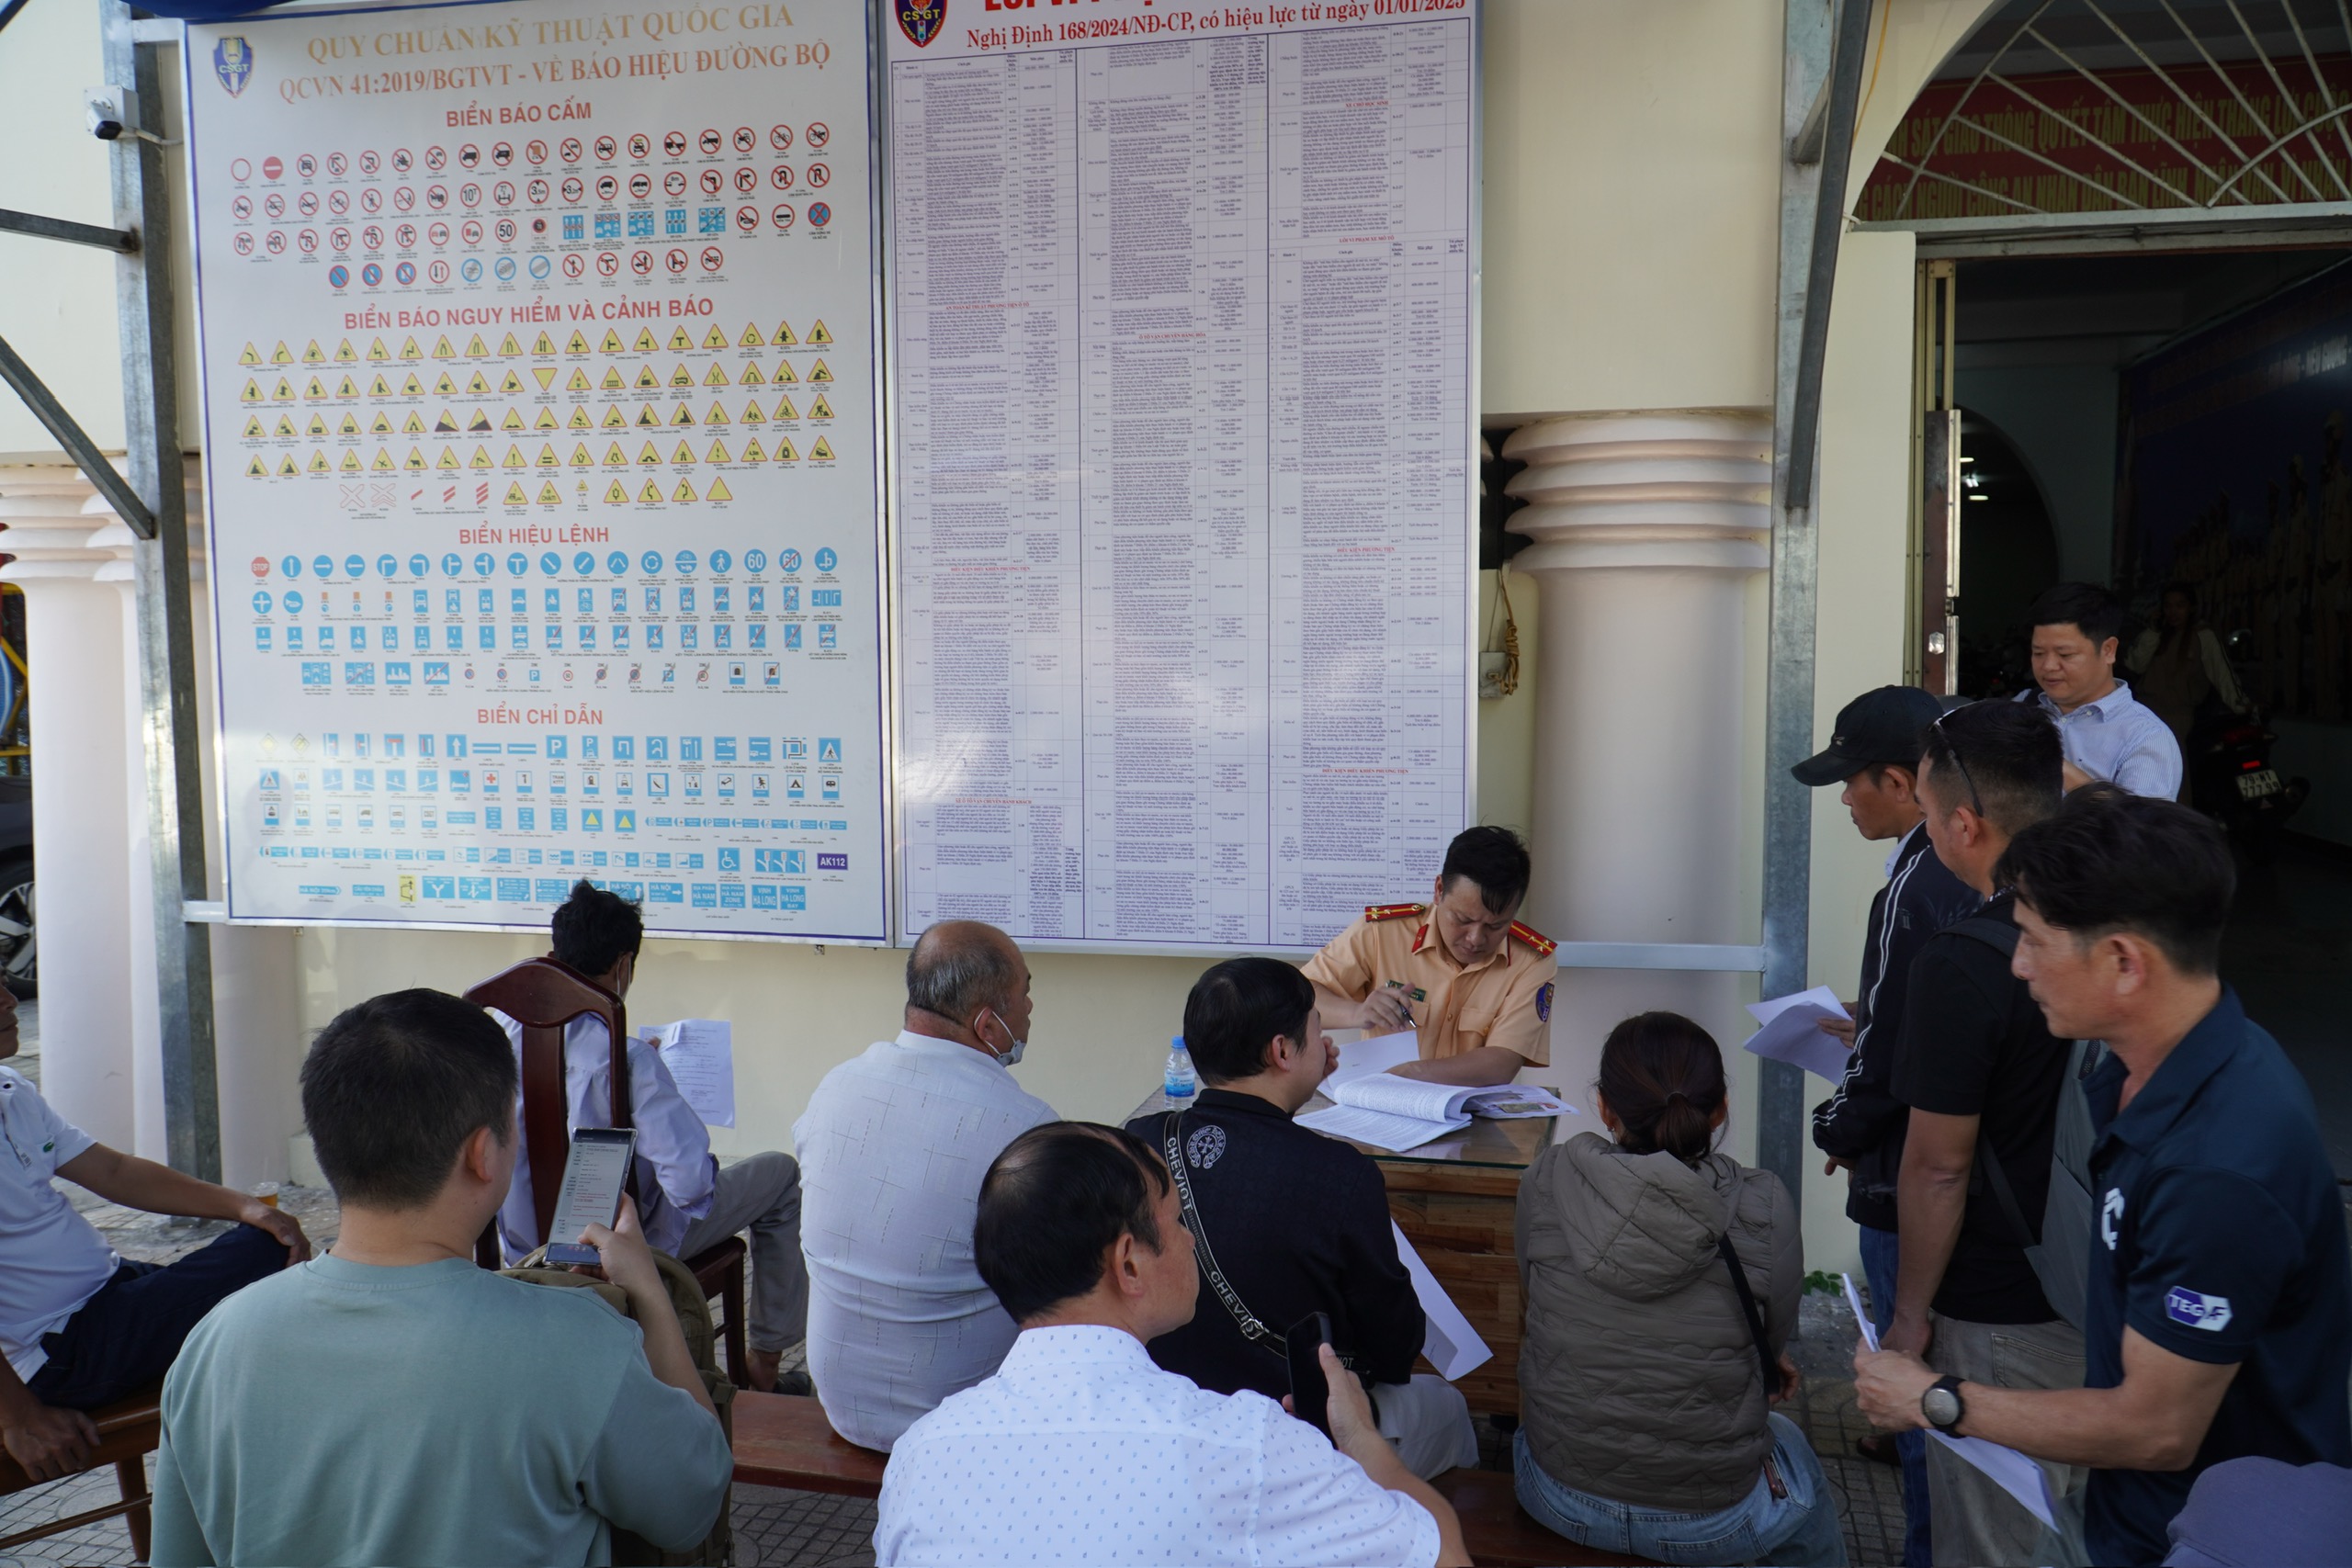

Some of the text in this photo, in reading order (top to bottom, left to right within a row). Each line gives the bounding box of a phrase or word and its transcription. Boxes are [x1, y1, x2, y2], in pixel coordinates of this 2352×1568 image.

[902, 9, 941, 22] CSGT
[967, 28, 1008, 51] Nghị
[1012, 24, 1054, 48] Định
[1059, 11, 1194, 41] 168/2024/NĐ-CP,
[1200, 10, 1220, 29] có
[1225, 6, 1263, 31] hiệu
[1269, 5, 1296, 29] lực
[1302, 1, 1322, 21] từ
[1326, 2, 1370, 22] ngày
[308, 2, 795, 65] QUY CHUẨN KỸ THUẬT QUỐC GIA
[280, 75, 344, 104] QCVN
[351, 64, 513, 95] 41:2019/BGTVT
[531, 54, 564, 84] VỀ
[571, 51, 621, 81] BÁO
[628, 50, 689, 81] HIỆU
[695, 42, 788, 73] ĐƯỜNG
[796, 39, 831, 70] BỘ
[446, 95, 592, 128] BIỂN BÁO CẤM
[1984, 104, 2035, 154] THÔNG
[2093, 100, 2125, 146] TÂM
[499, 224, 513, 238] 50
[345, 294, 715, 330] BIỂN BÁO NGUY HIỂM VÀ CẢNH BÁO
[459, 520, 610, 547] BIỂN HIỆU LỆNH
[251, 561, 270, 572] STOP
[747, 553, 763, 570] 60
[477, 701, 604, 725] BIỂN CHỈ DẪN
[551, 739, 562, 755] P
[586, 737, 594, 748] P
[820, 856, 846, 867] AK112
[1167, 1136, 1193, 1211] CHEVIOT
